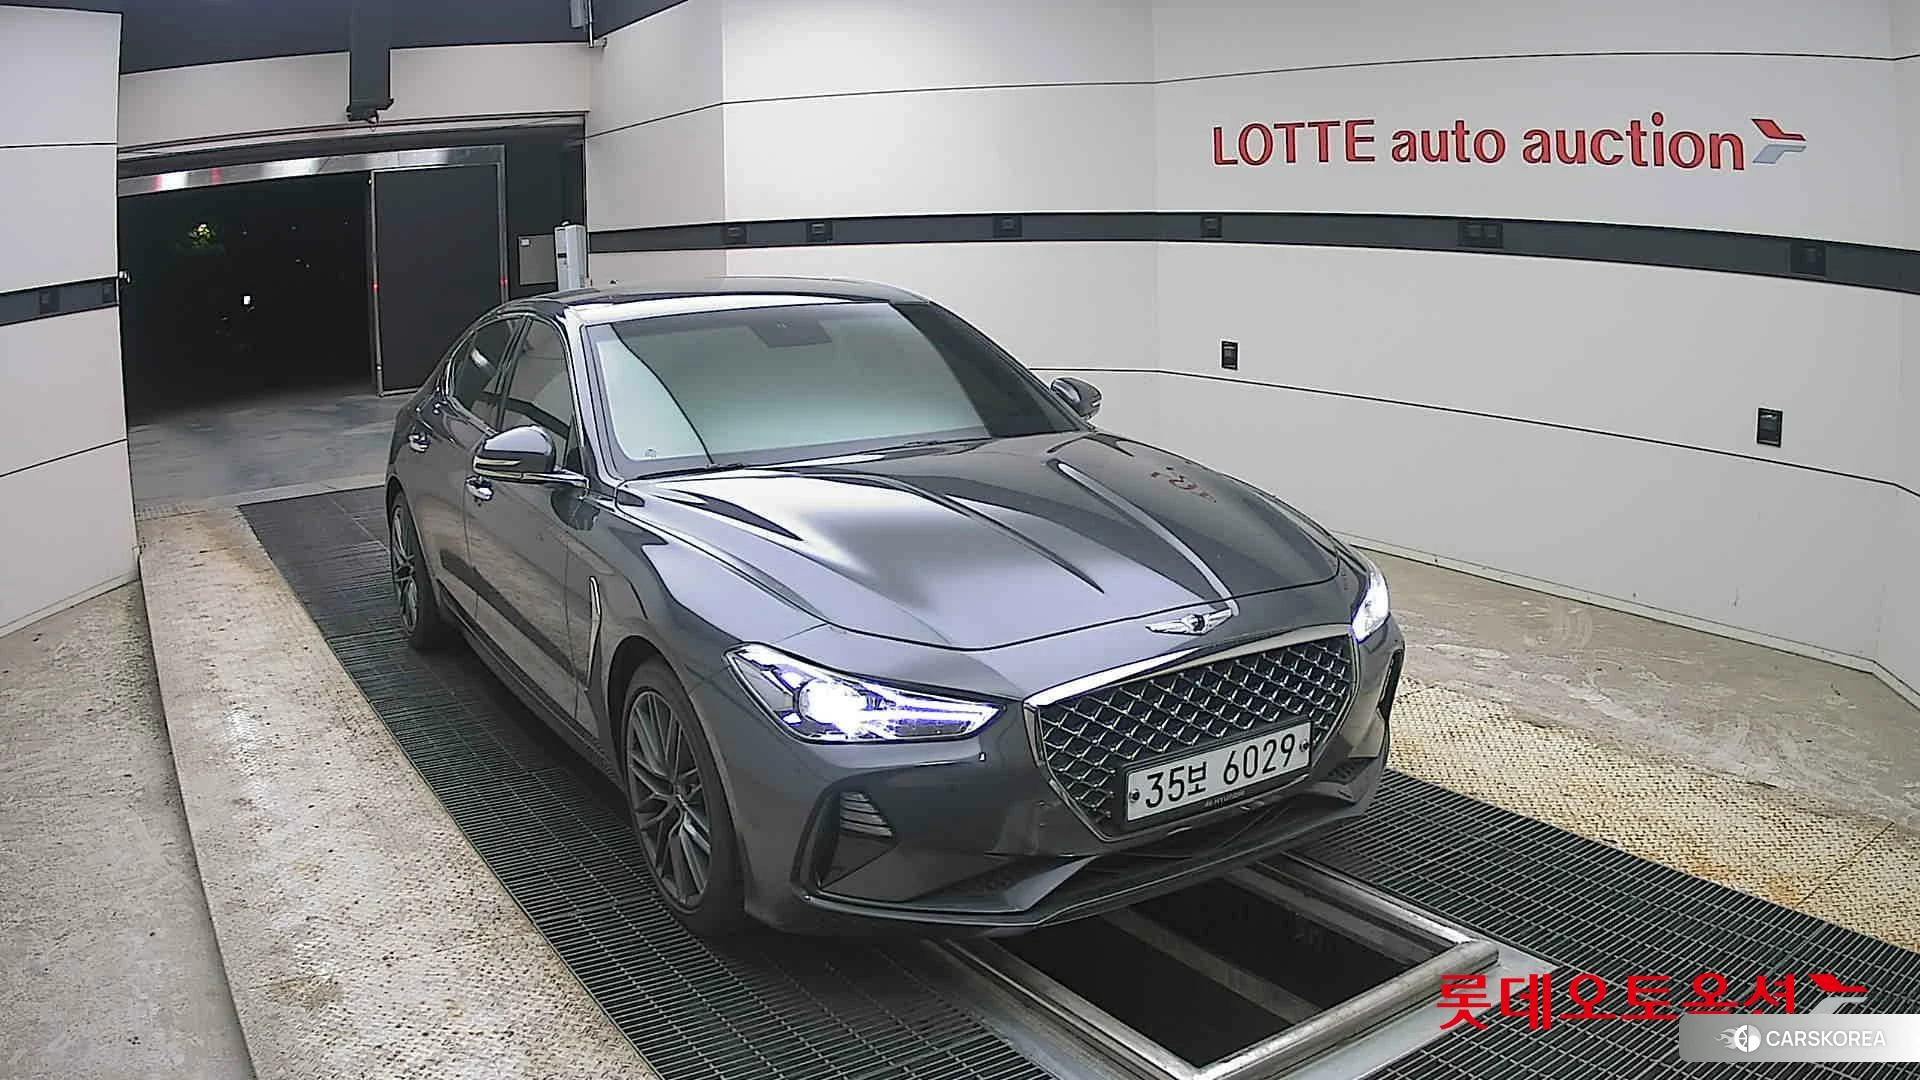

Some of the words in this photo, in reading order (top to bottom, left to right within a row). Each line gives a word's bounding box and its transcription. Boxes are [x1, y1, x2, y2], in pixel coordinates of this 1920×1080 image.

[1212, 119, 1375, 166] LOTTE
[1392, 120, 1506, 164] auto
[1522, 112, 1745, 170] auction
[1145, 761, 1207, 808] 35보
[1223, 734, 1295, 785] 6029
